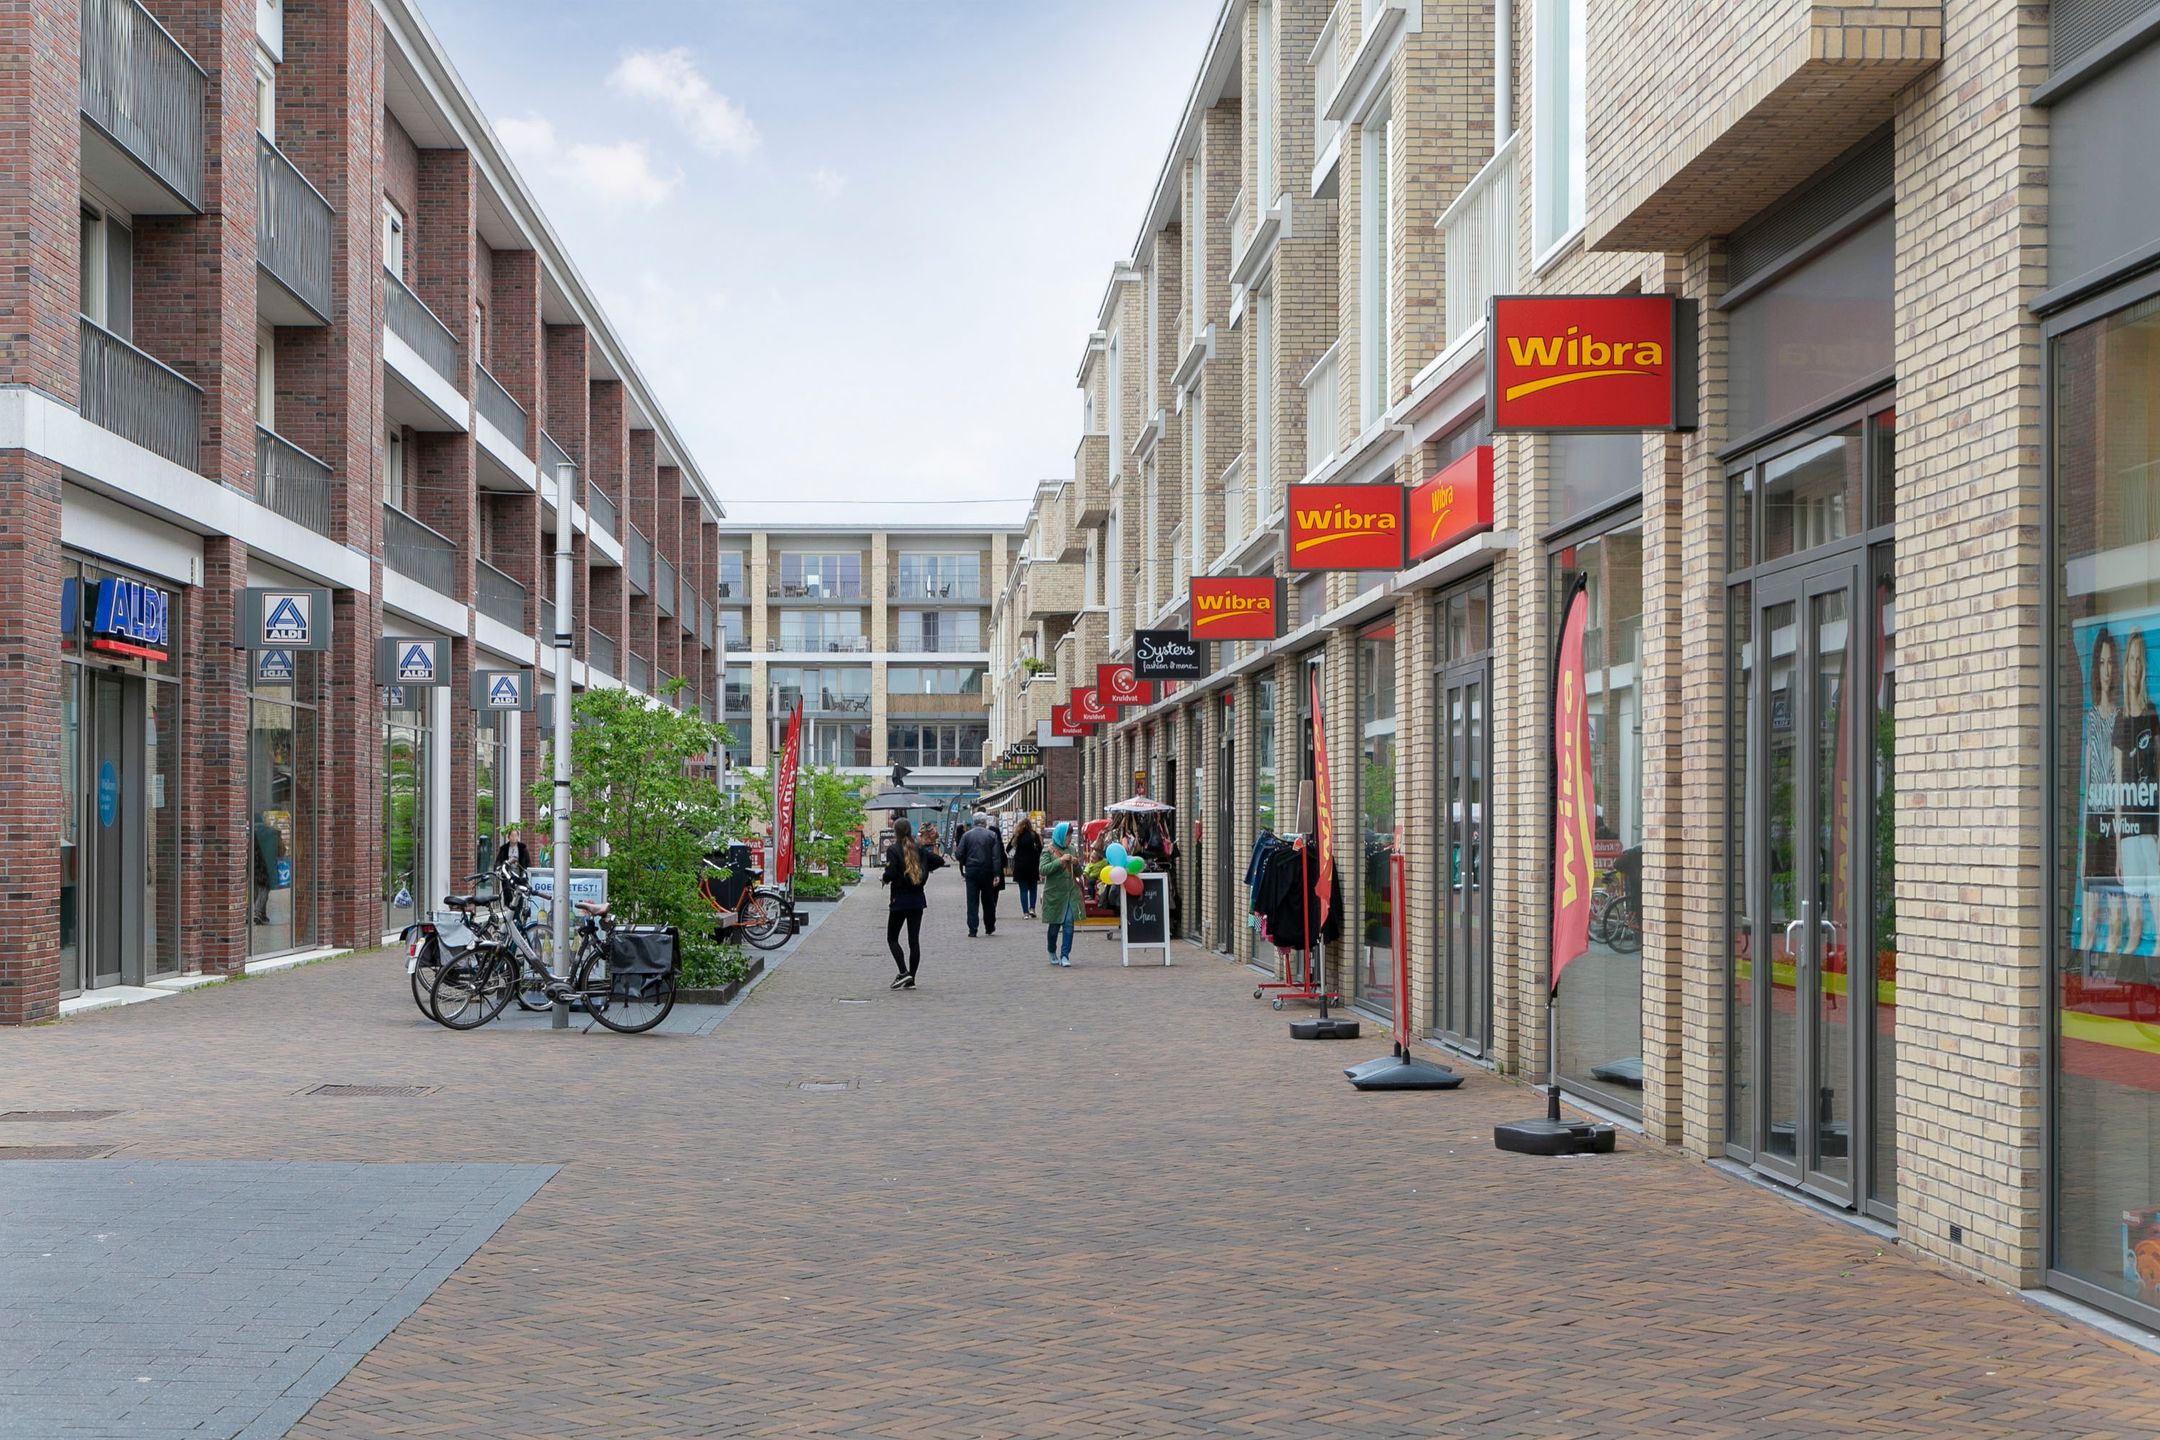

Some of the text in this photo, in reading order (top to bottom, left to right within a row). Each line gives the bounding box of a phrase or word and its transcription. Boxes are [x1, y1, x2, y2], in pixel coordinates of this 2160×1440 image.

[1505, 325, 1664, 367] Wibra
[1431, 480, 1454, 514] Wibra
[1296, 503, 1396, 529] Wibra
[108, 577, 168, 645] ALDI
[1196, 590, 1271, 610] Wibra
[269, 629, 303, 639] ALDI
[1137, 637, 1195, 663] Systers
[1143, 660, 1168, 673] fashion
[1111, 694, 1138, 702] Kruidvat
[1012, 744, 1040, 755] KEES
[1558, 670, 1577, 910] Wibra
[2088, 782, 2158, 807] summer
[2100, 817, 2140, 838] by Wibra
[534, 882, 554, 891] GOE
[1133, 902, 1157, 924] Open
